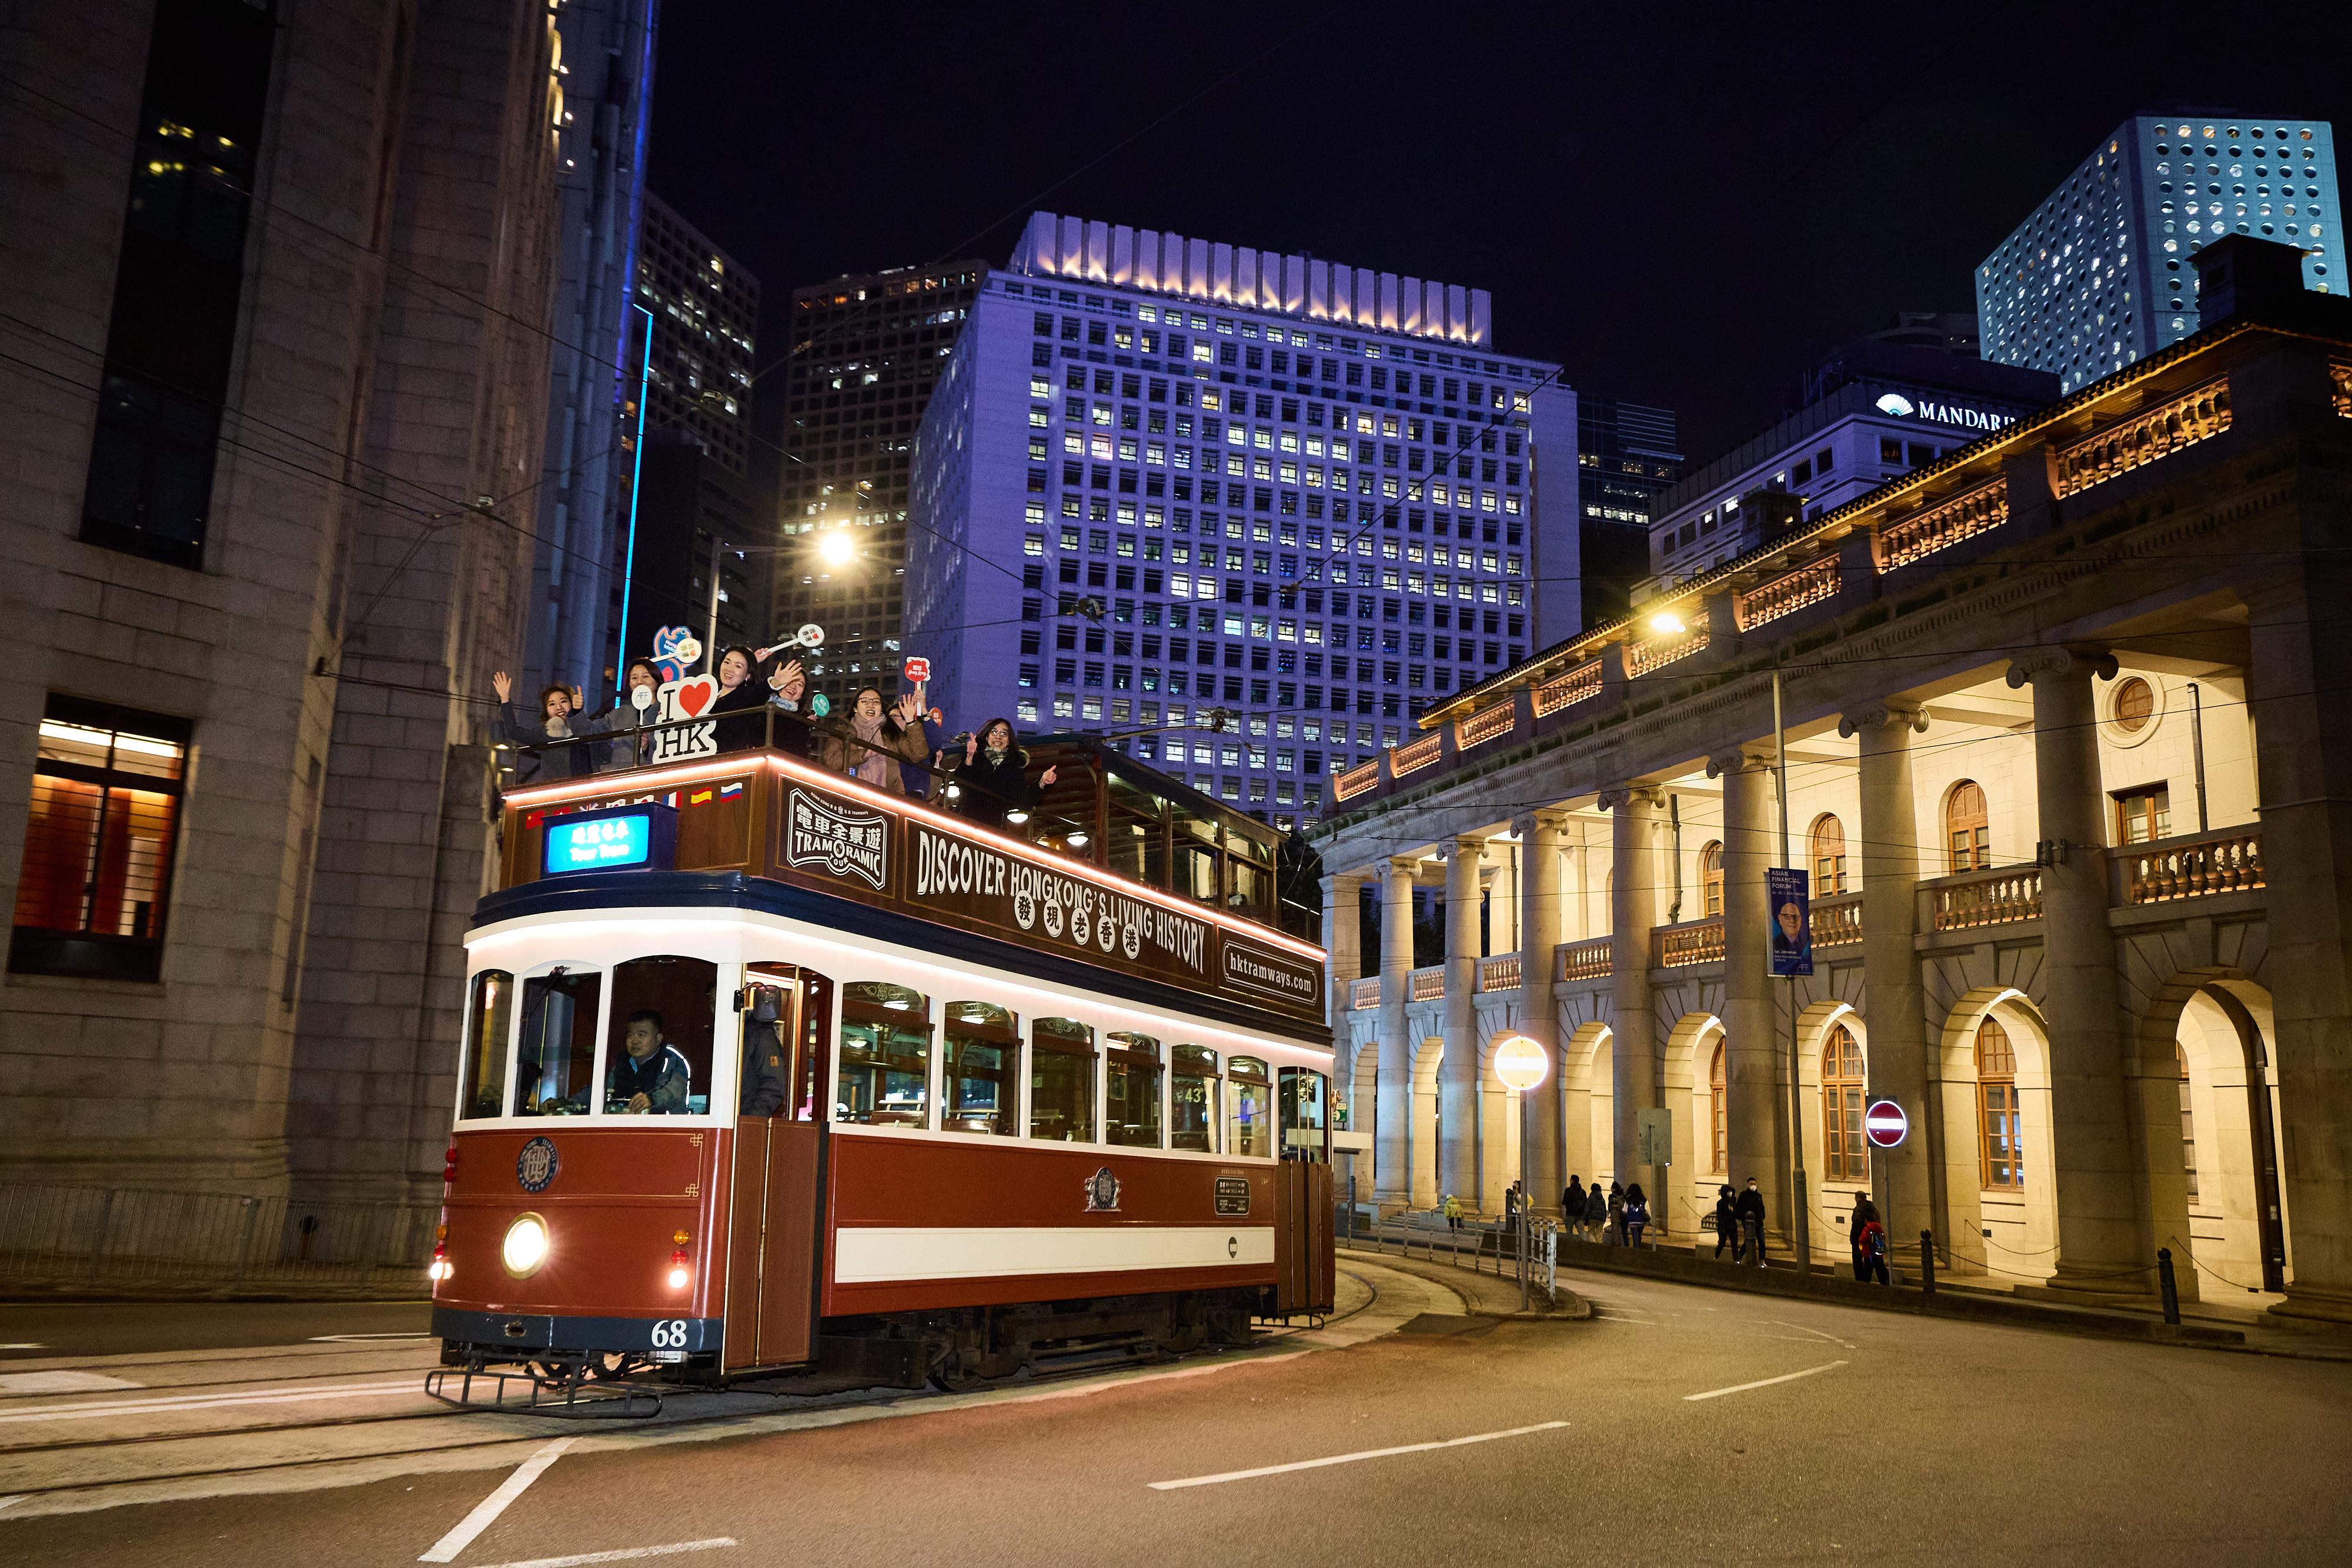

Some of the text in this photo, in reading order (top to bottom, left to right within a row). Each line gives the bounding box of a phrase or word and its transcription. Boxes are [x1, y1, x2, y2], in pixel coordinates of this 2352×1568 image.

[662, 689, 676, 723] I
[659, 722, 710, 759] HK
[796, 803, 881, 850] 電車全景遊
[795, 830, 881, 877] TRAMORAMIC
[830, 853, 849, 867] TOUR
[917, 830, 1005, 896] DISCOVER
[1110, 895, 1153, 940] LIVING
[1157, 911, 1205, 974] HISTORY
[1018, 896, 1136, 952] 發現老香港
[1230, 952, 1312, 992] hktramways.com
[651, 1319, 687, 1348] 68
